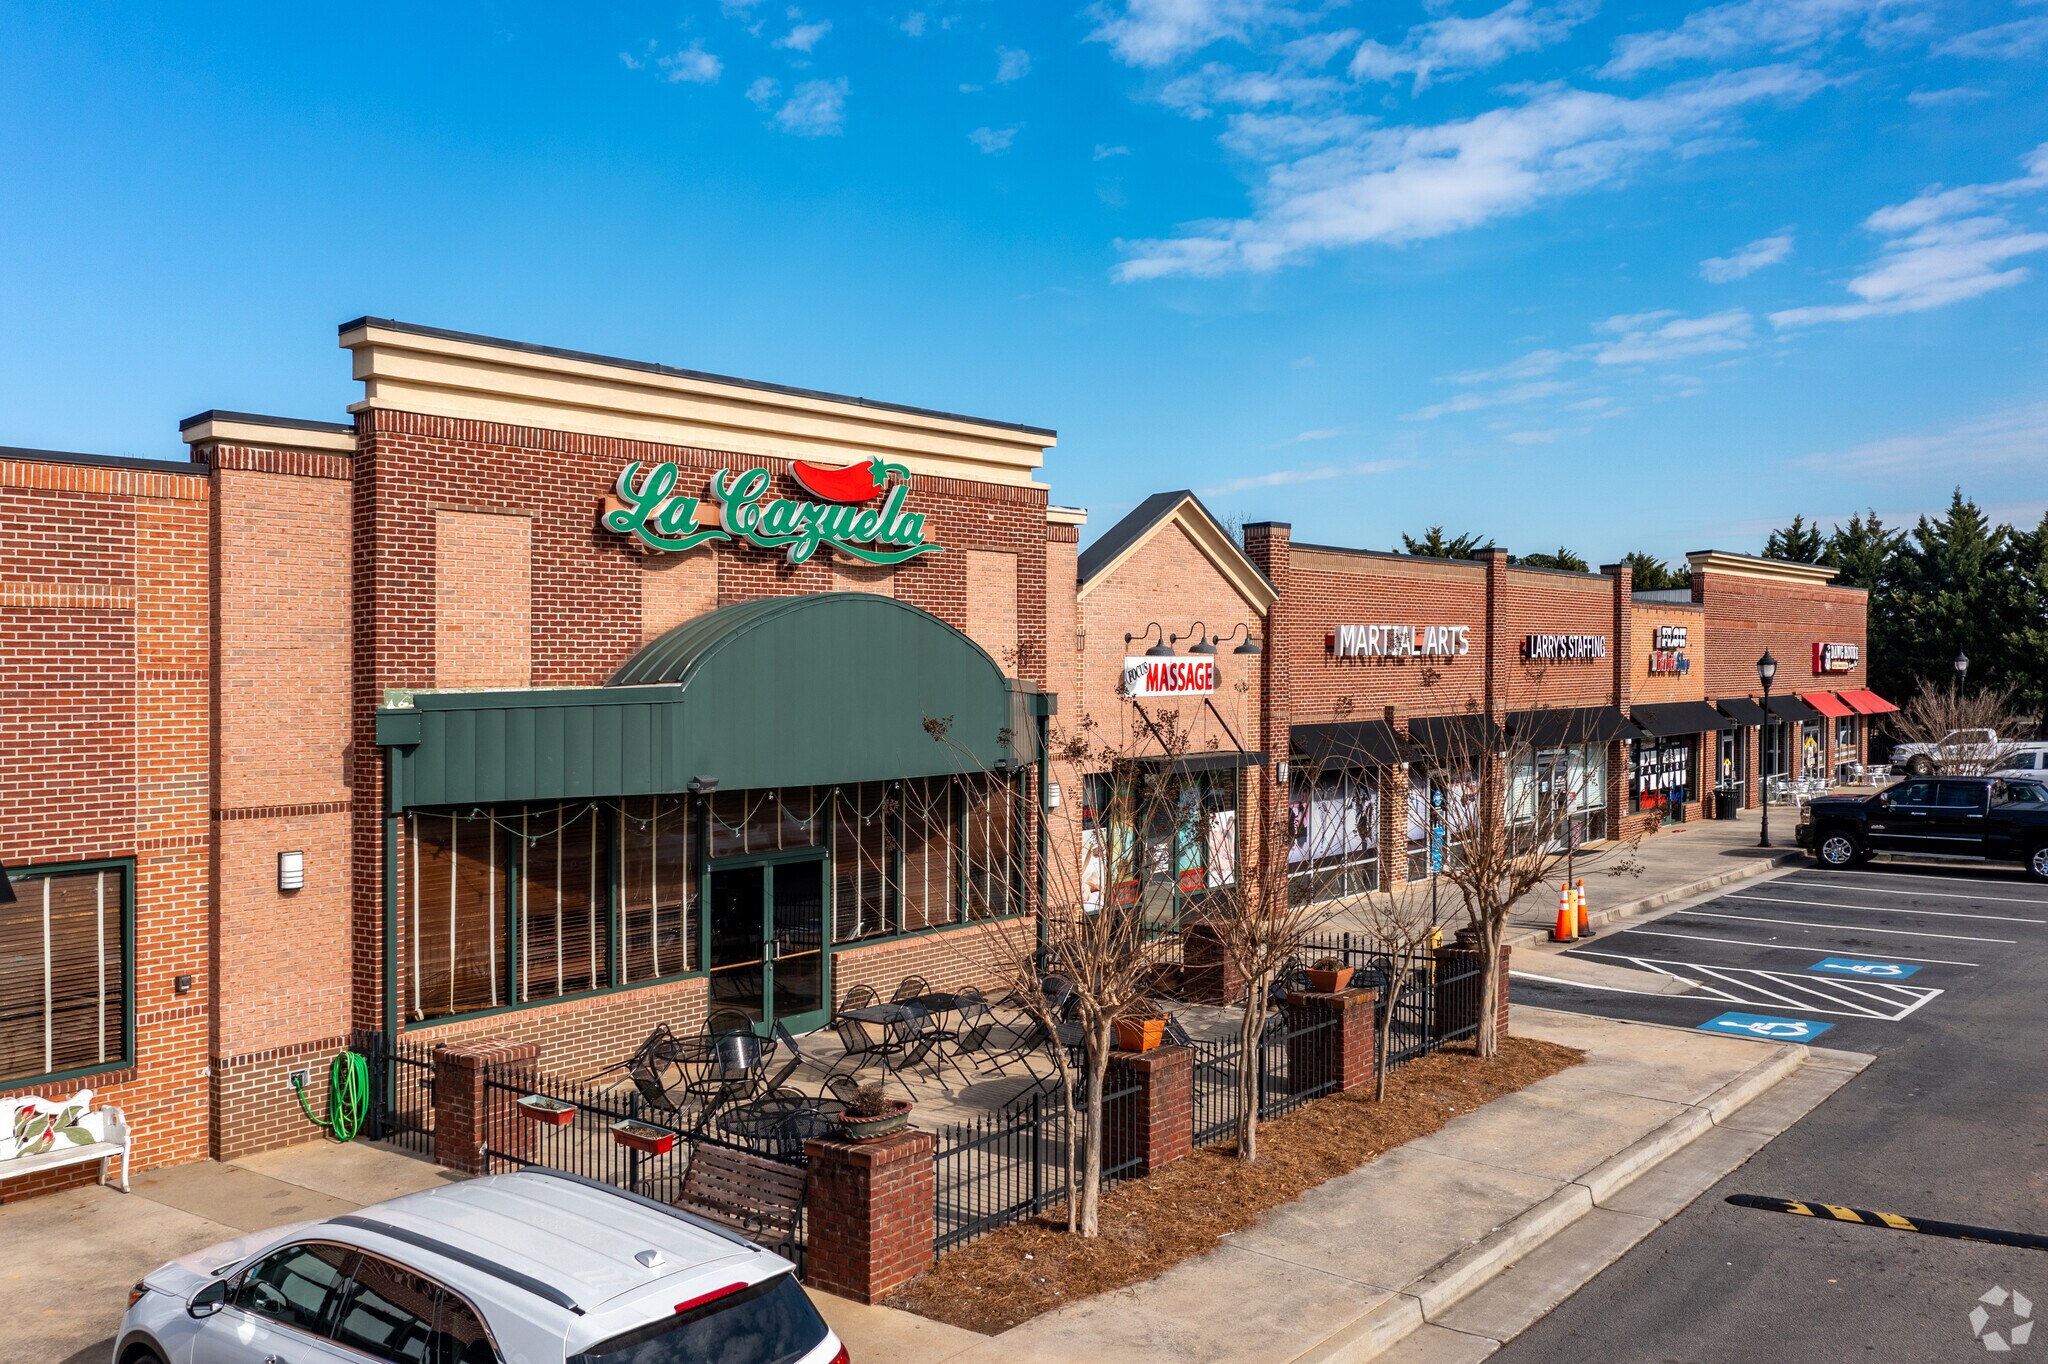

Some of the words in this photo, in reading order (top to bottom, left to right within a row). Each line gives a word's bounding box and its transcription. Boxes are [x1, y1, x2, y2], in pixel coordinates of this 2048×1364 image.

[604, 461, 731, 551] La
[712, 467, 944, 564] Cazuela
[1338, 625, 1420, 656] MARTIAL
[1426, 626, 1470, 656] ARTS
[1531, 634, 1566, 658] LARRY'S
[1568, 635, 1605, 658] STAFFING
[1127, 661, 1149, 683] FOCUS
[1146, 663, 1212, 692] MASSAGE
